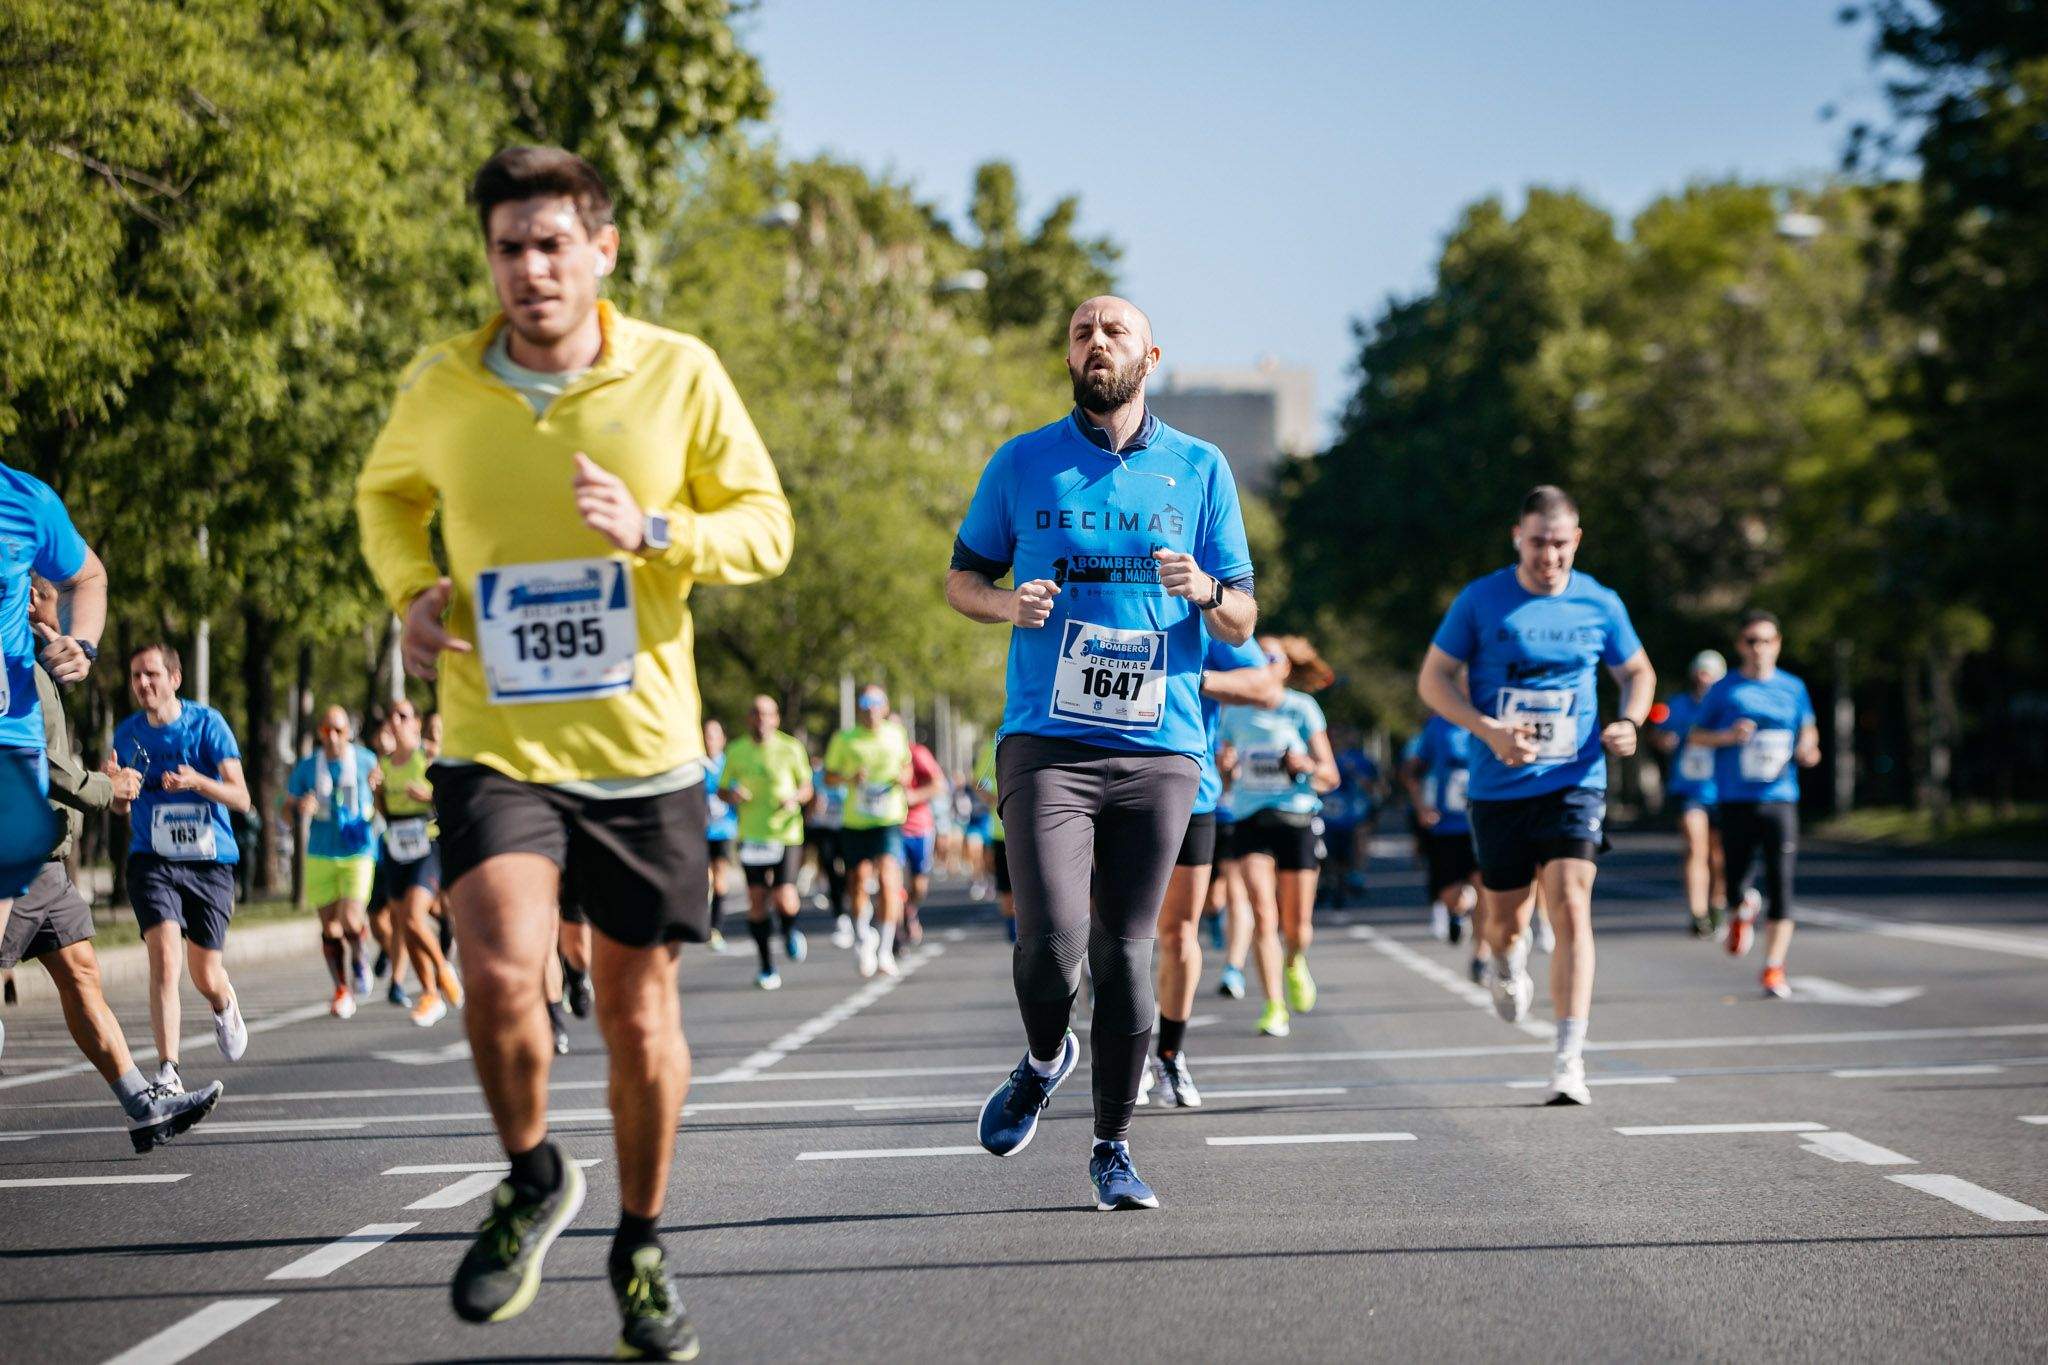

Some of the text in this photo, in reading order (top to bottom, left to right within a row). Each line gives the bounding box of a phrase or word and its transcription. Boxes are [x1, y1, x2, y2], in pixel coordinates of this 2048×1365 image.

[1036, 510, 1184, 535] DECIMAS
[1077, 556, 1162, 569] BOMBEROS
[1110, 569, 1122, 582] de
[511, 618, 604, 661] 1395
[1099, 640, 1150, 653] BOMBEROS
[1090, 656, 1147, 670] DECIMAS
[1082, 667, 1144, 701] 1647
[170, 828, 197, 845] 163
